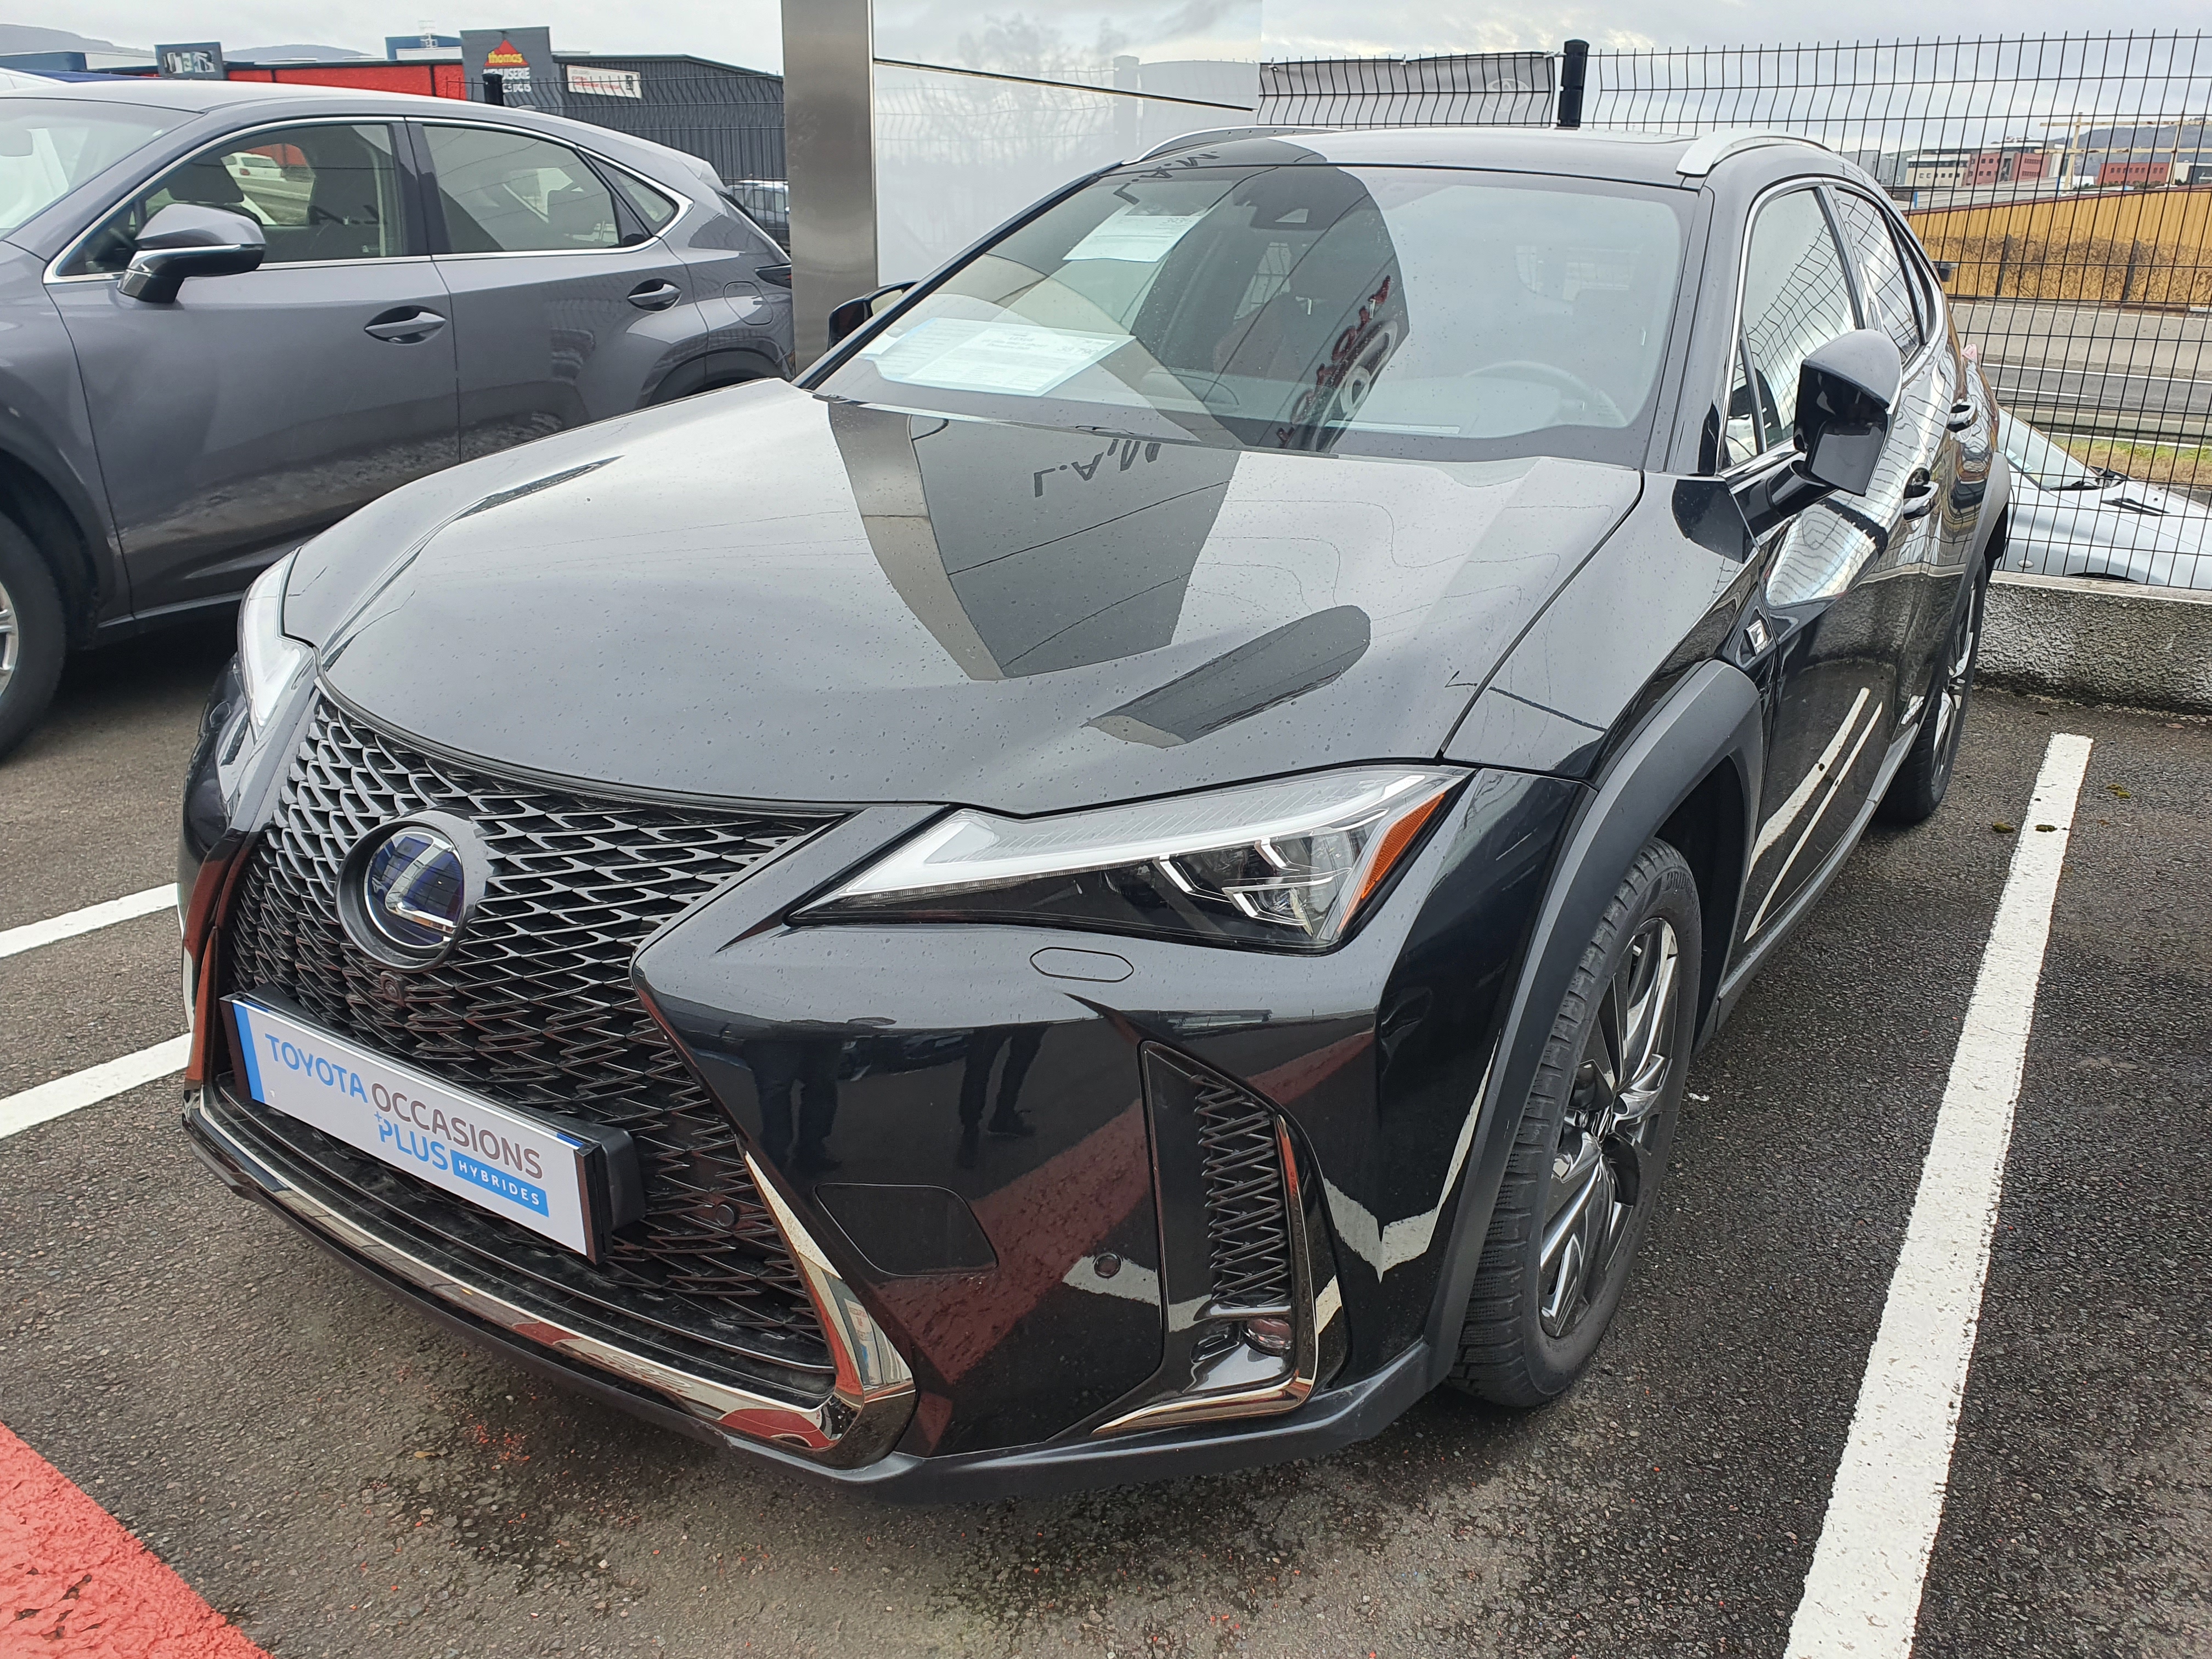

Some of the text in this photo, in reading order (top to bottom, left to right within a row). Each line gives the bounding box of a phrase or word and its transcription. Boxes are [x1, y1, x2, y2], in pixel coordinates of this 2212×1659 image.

[265, 1032, 543, 1179] TOYOTA OCCASIONS
[379, 1118, 539, 1206] PLUS HYBRIDES
